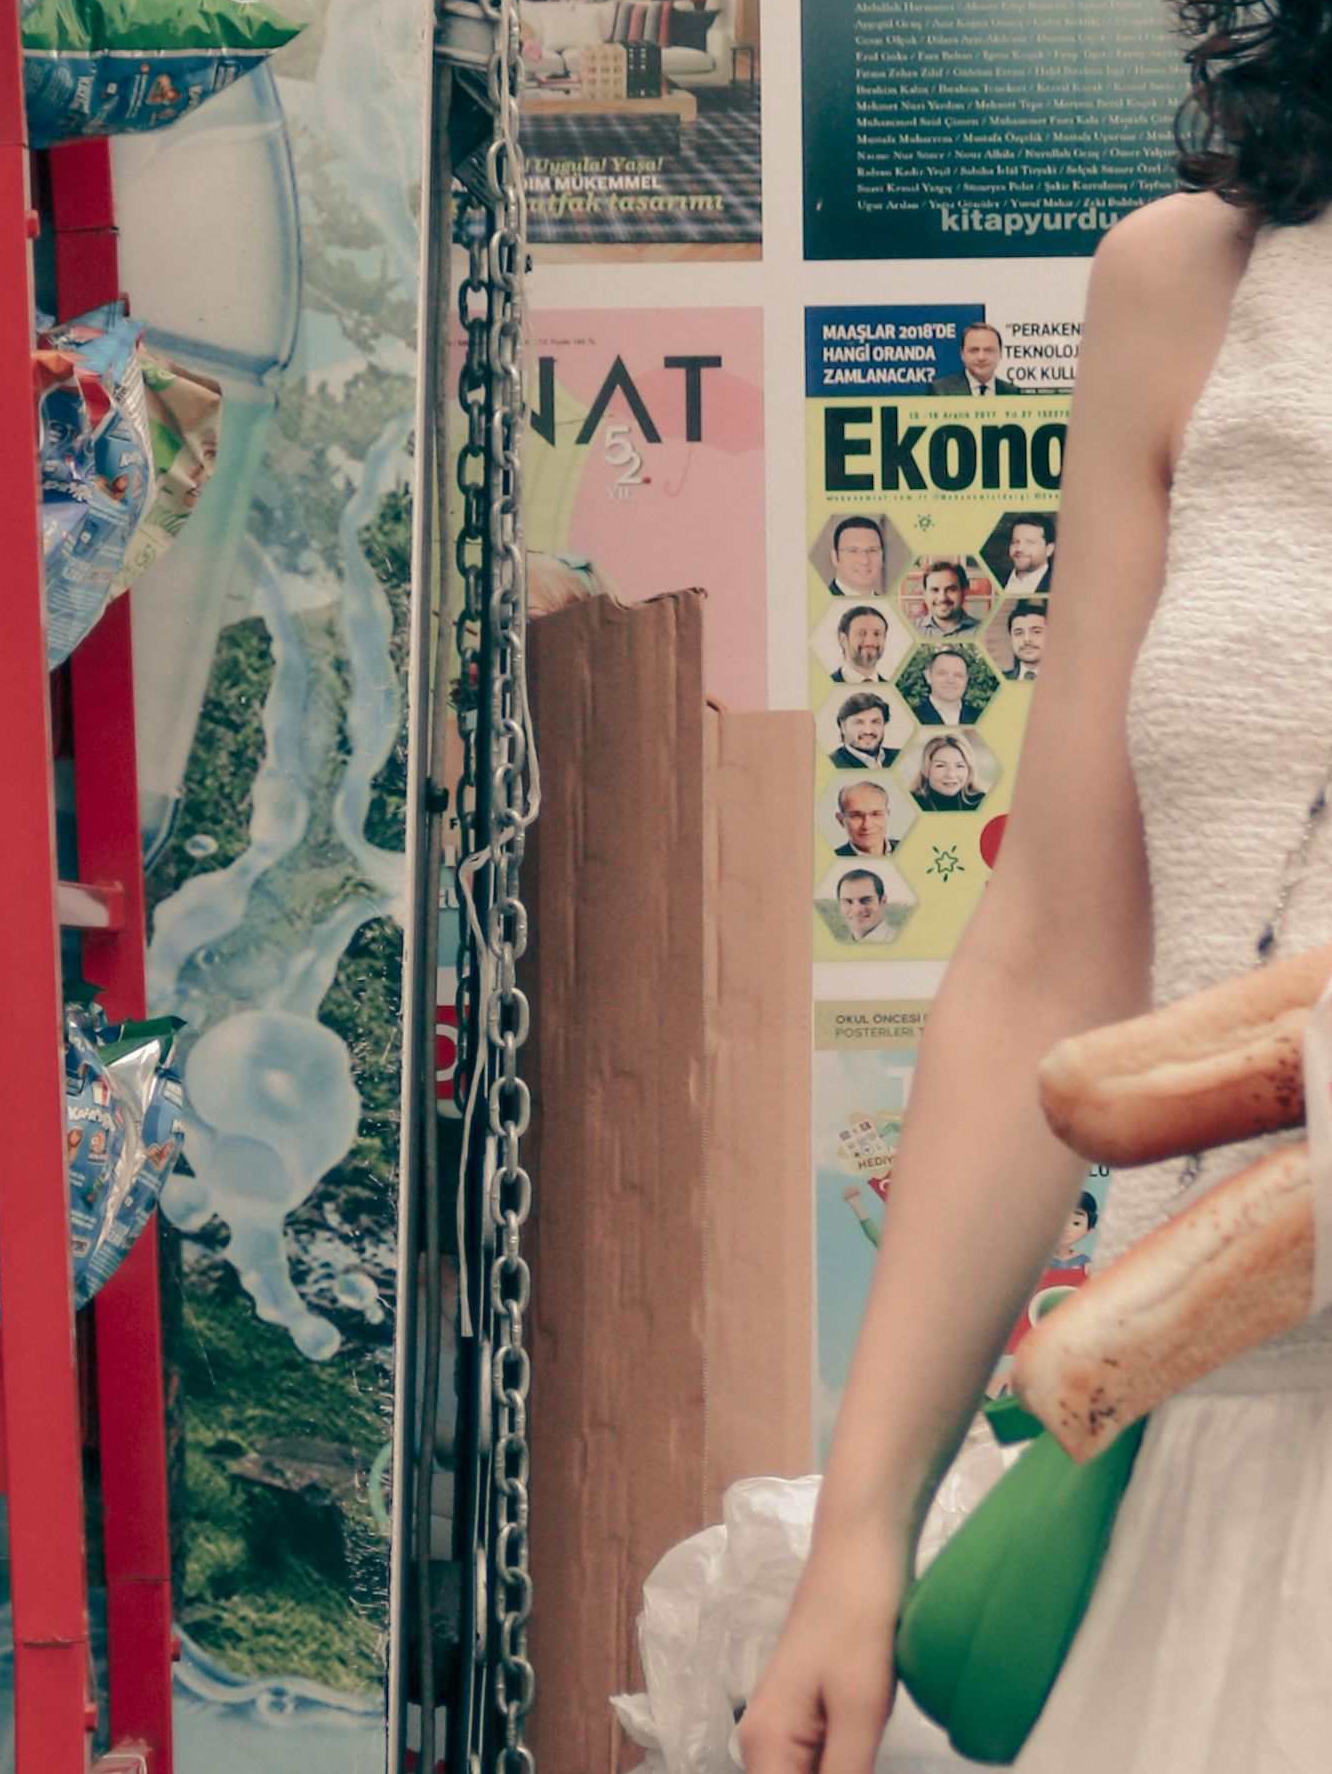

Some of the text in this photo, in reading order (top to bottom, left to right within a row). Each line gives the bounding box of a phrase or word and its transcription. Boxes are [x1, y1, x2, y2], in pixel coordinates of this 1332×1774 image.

[554, 174, 662, 191] MÜKEMMEL
[529, 192, 602, 218] utfak
[822, 323, 896, 344] MAAŞLAR
[1005, 322, 1083, 336] "PERAKEN
[822, 343, 936, 363] HANGİ ORANDA
[823, 366, 936, 385] ZAMLANACAK?
[1006, 366, 1038, 386] ÇOK
[835, 1014, 869, 1024] OKUL
[858, 1155, 895, 1171] HEDİY
